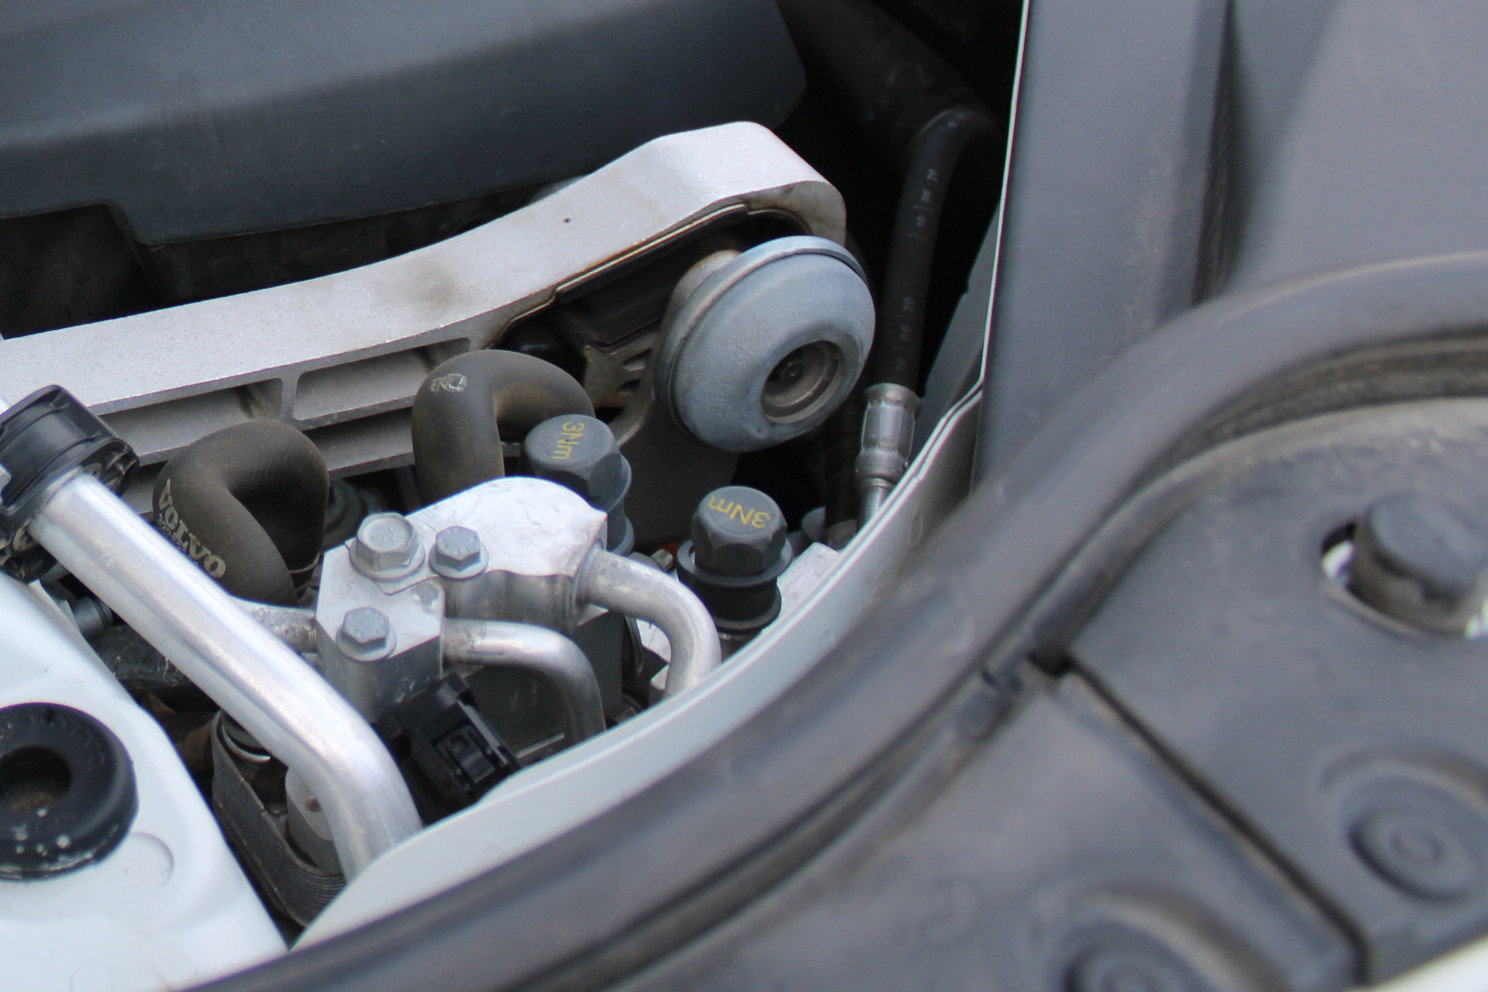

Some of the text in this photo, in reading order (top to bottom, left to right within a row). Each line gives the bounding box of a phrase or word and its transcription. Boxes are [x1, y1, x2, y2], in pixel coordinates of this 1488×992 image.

[551, 421, 586, 461] 3Nm
[158, 477, 227, 579] VOLVO
[708, 494, 772, 529] 3Nm
